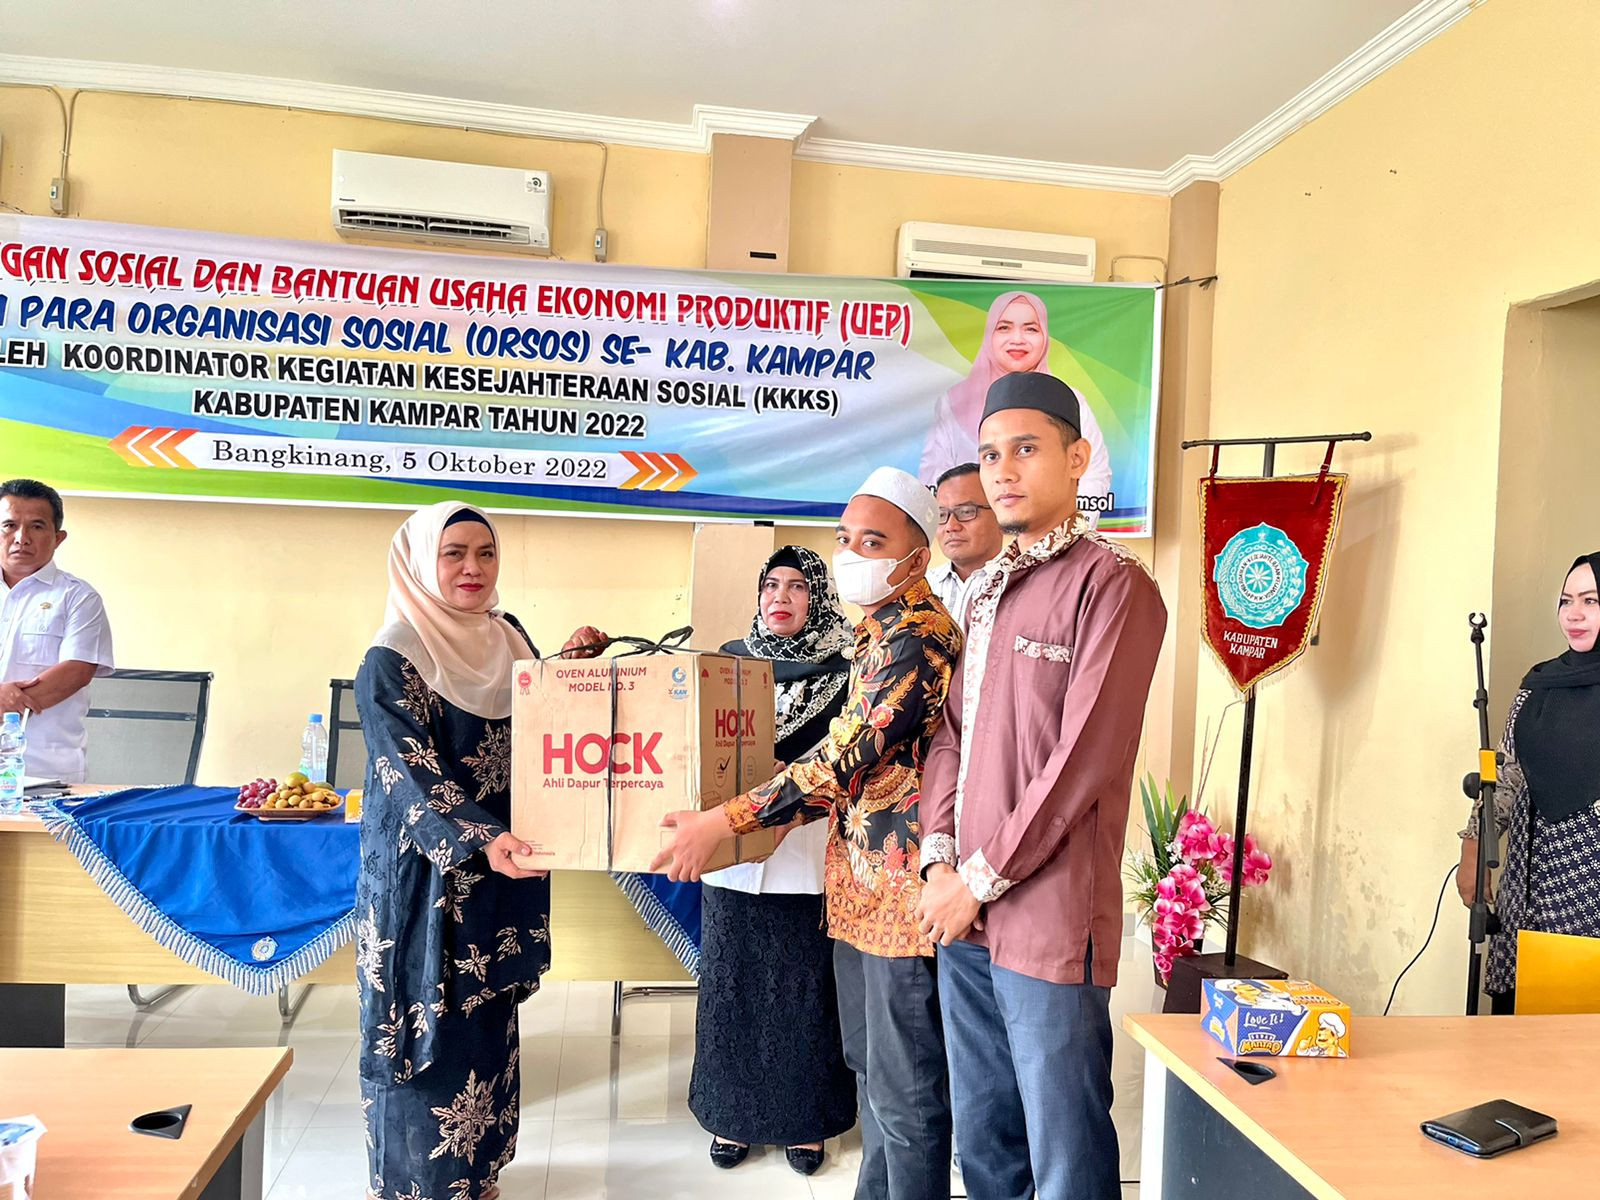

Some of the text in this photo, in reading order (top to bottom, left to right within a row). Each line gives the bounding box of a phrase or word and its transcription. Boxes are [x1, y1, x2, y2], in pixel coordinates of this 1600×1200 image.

[0, 243, 910, 347] GAN SOSIAL DAN BANTUAN USAHA EKONOMI PRODUKTIF (UEP)
[20, 296, 115, 332] PARA
[128, 302, 332, 346] ORGANISASI
[341, 316, 451, 353] SOSIAL
[466, 322, 590, 363] (ORSOS)
[600, 333, 651, 365] SE-
[665, 338, 734, 372] KAB.
[746, 344, 876, 380] KAMPAR
[63, 344, 268, 379] KOORDINATOR
[278, 356, 414, 387] KEGIATAN
[424, 366, 649, 402] KESEJAHTERAAN
[657, 380, 745, 407] SOSIAL
[754, 386, 838, 416] (KKKS)
[194, 390, 645, 438] KABUPATEN KAMPAR TAHUN 2022
[212, 440, 607, 479] Bangkinang, 5 Oktober 2022
[1223, 630, 1279, 649] KABUPATEN
[1229, 643, 1266, 659] KAMPAR
[556, 668, 585, 679] OVEN
[568, 682, 605, 692] MODEL
[628, 681, 635, 691] 3
[543, 732, 663, 774] HOCK
[543, 778, 564, 788] Ahli
[567, 778, 601, 790] Dapur
[1243, 1011, 1268, 1028] Love
